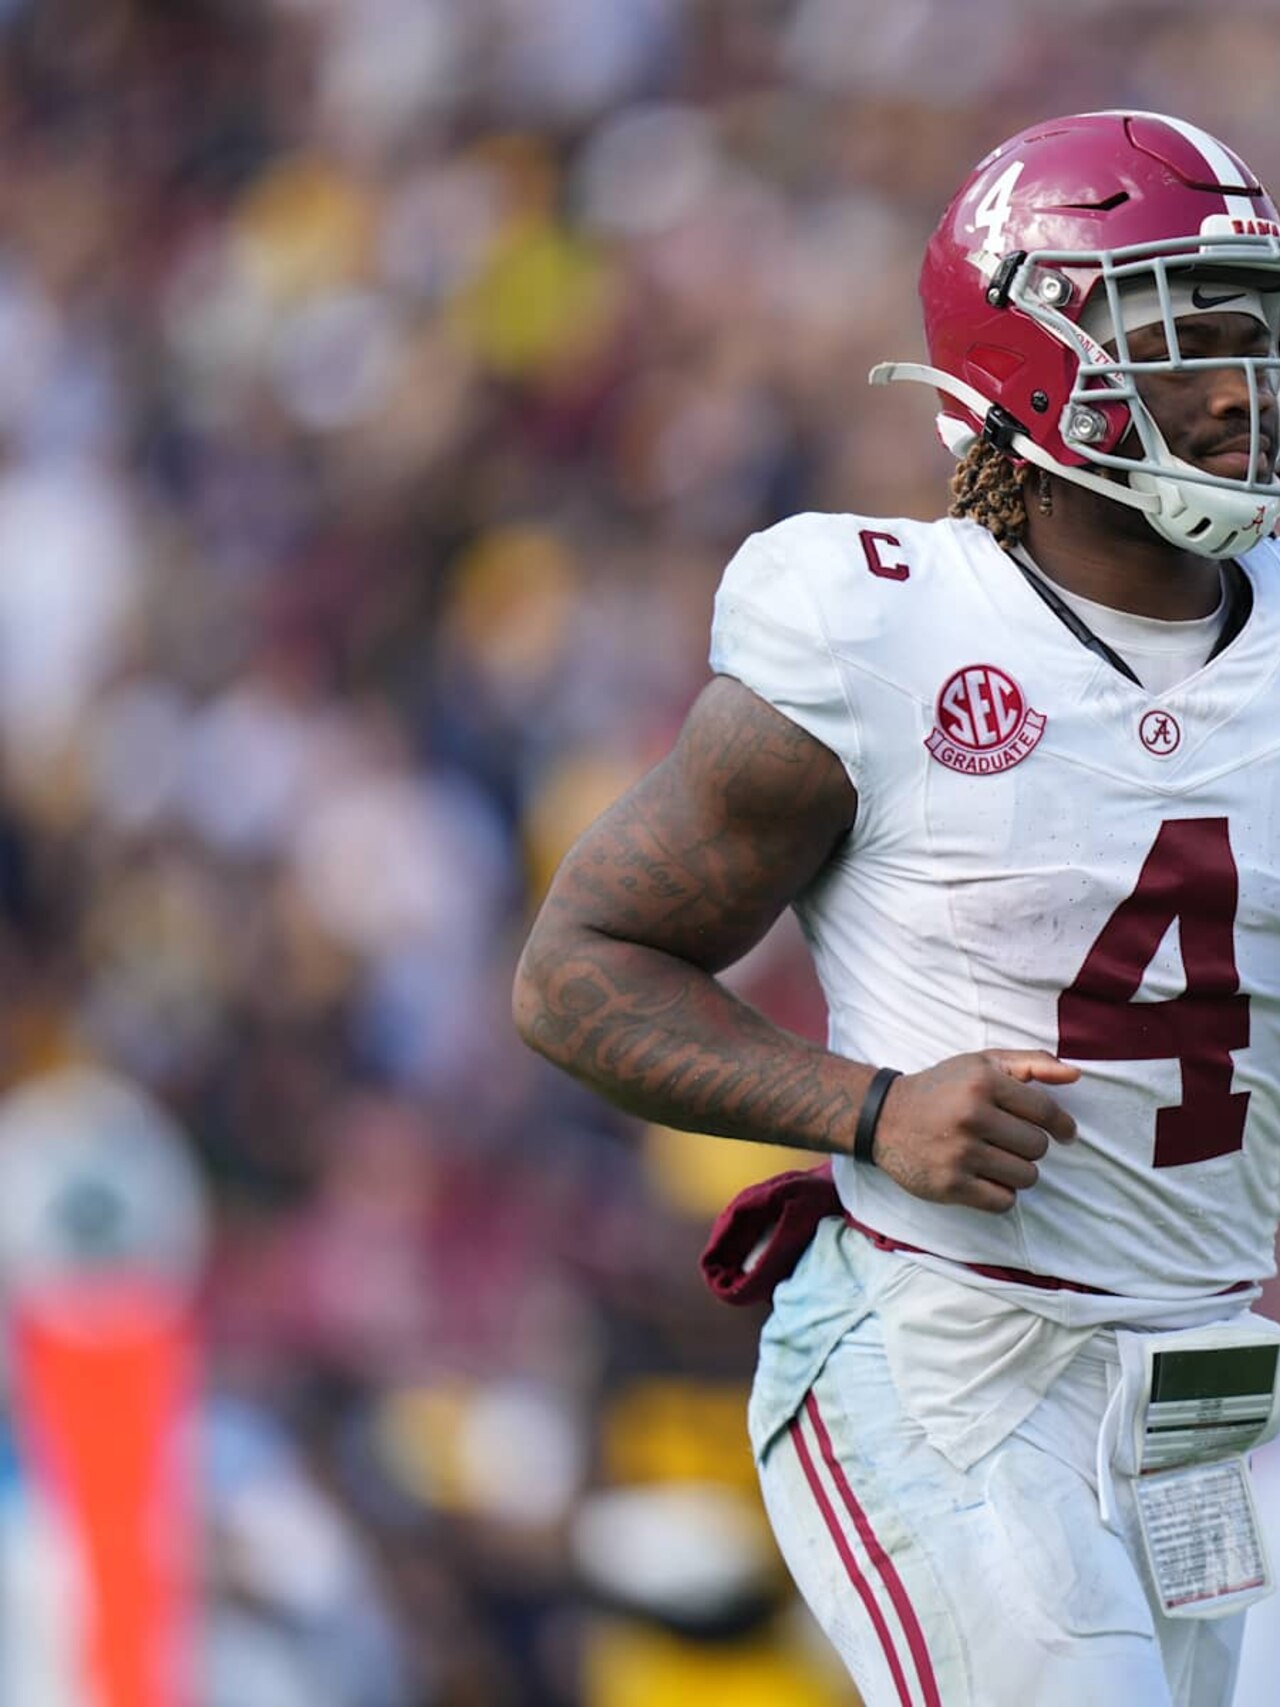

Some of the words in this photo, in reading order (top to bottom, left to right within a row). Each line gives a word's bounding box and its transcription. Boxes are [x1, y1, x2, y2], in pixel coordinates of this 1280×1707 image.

[975, 160, 1024, 253] 4
[858, 529, 910, 582] C
[941, 670, 1018, 747] SEC
[941, 731, 1034, 772] GRADUATE
[1057, 817, 1251, 1168] 4
